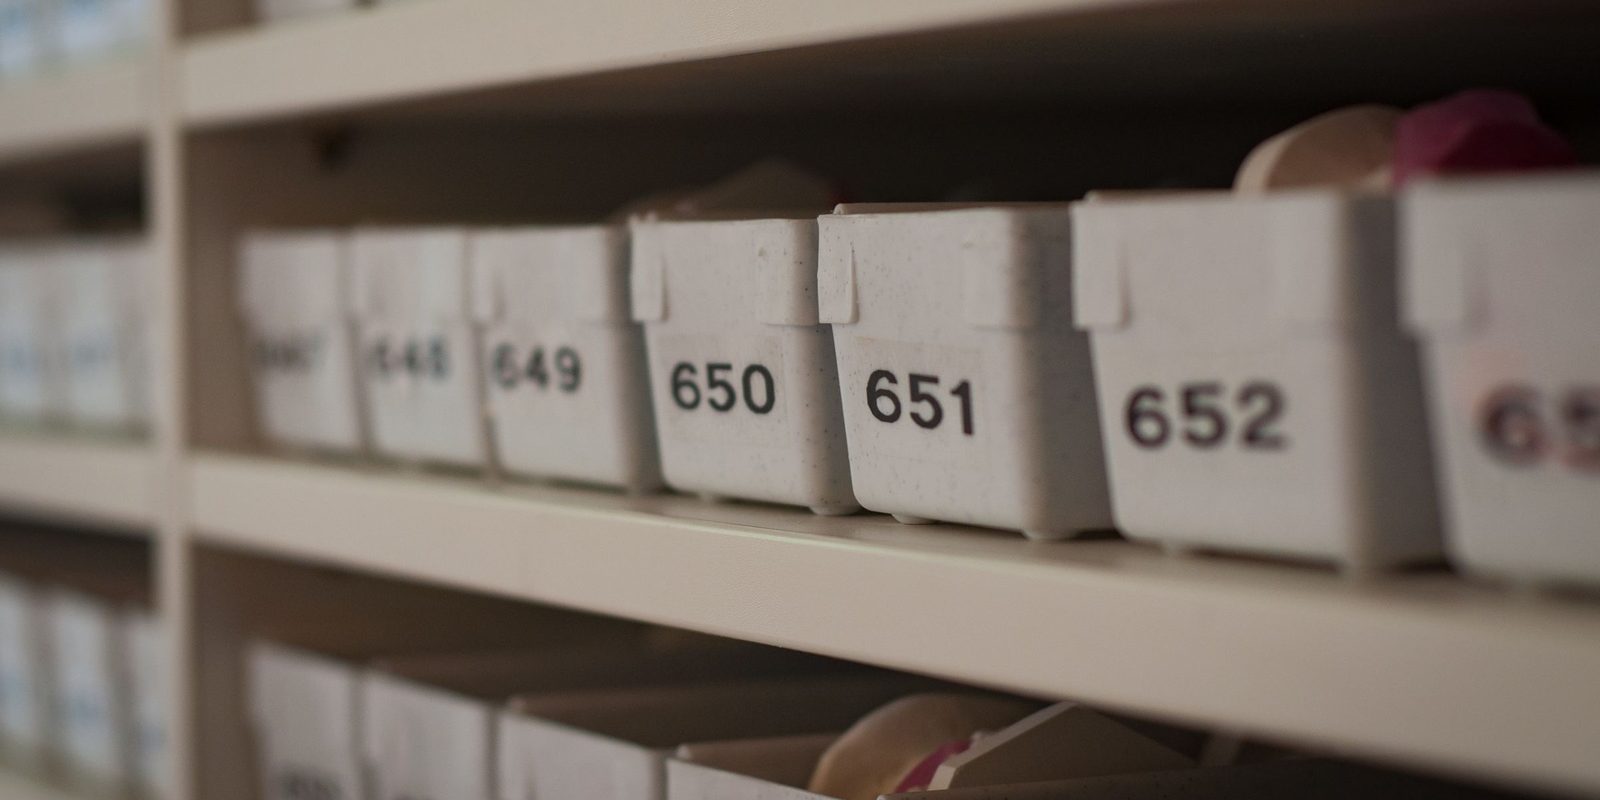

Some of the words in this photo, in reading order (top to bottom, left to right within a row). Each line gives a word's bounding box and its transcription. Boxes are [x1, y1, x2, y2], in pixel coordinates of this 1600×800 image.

[491, 344, 582, 394] 649
[670, 362, 776, 415] 650
[866, 369, 975, 437] 651
[1123, 380, 1290, 452] 652
